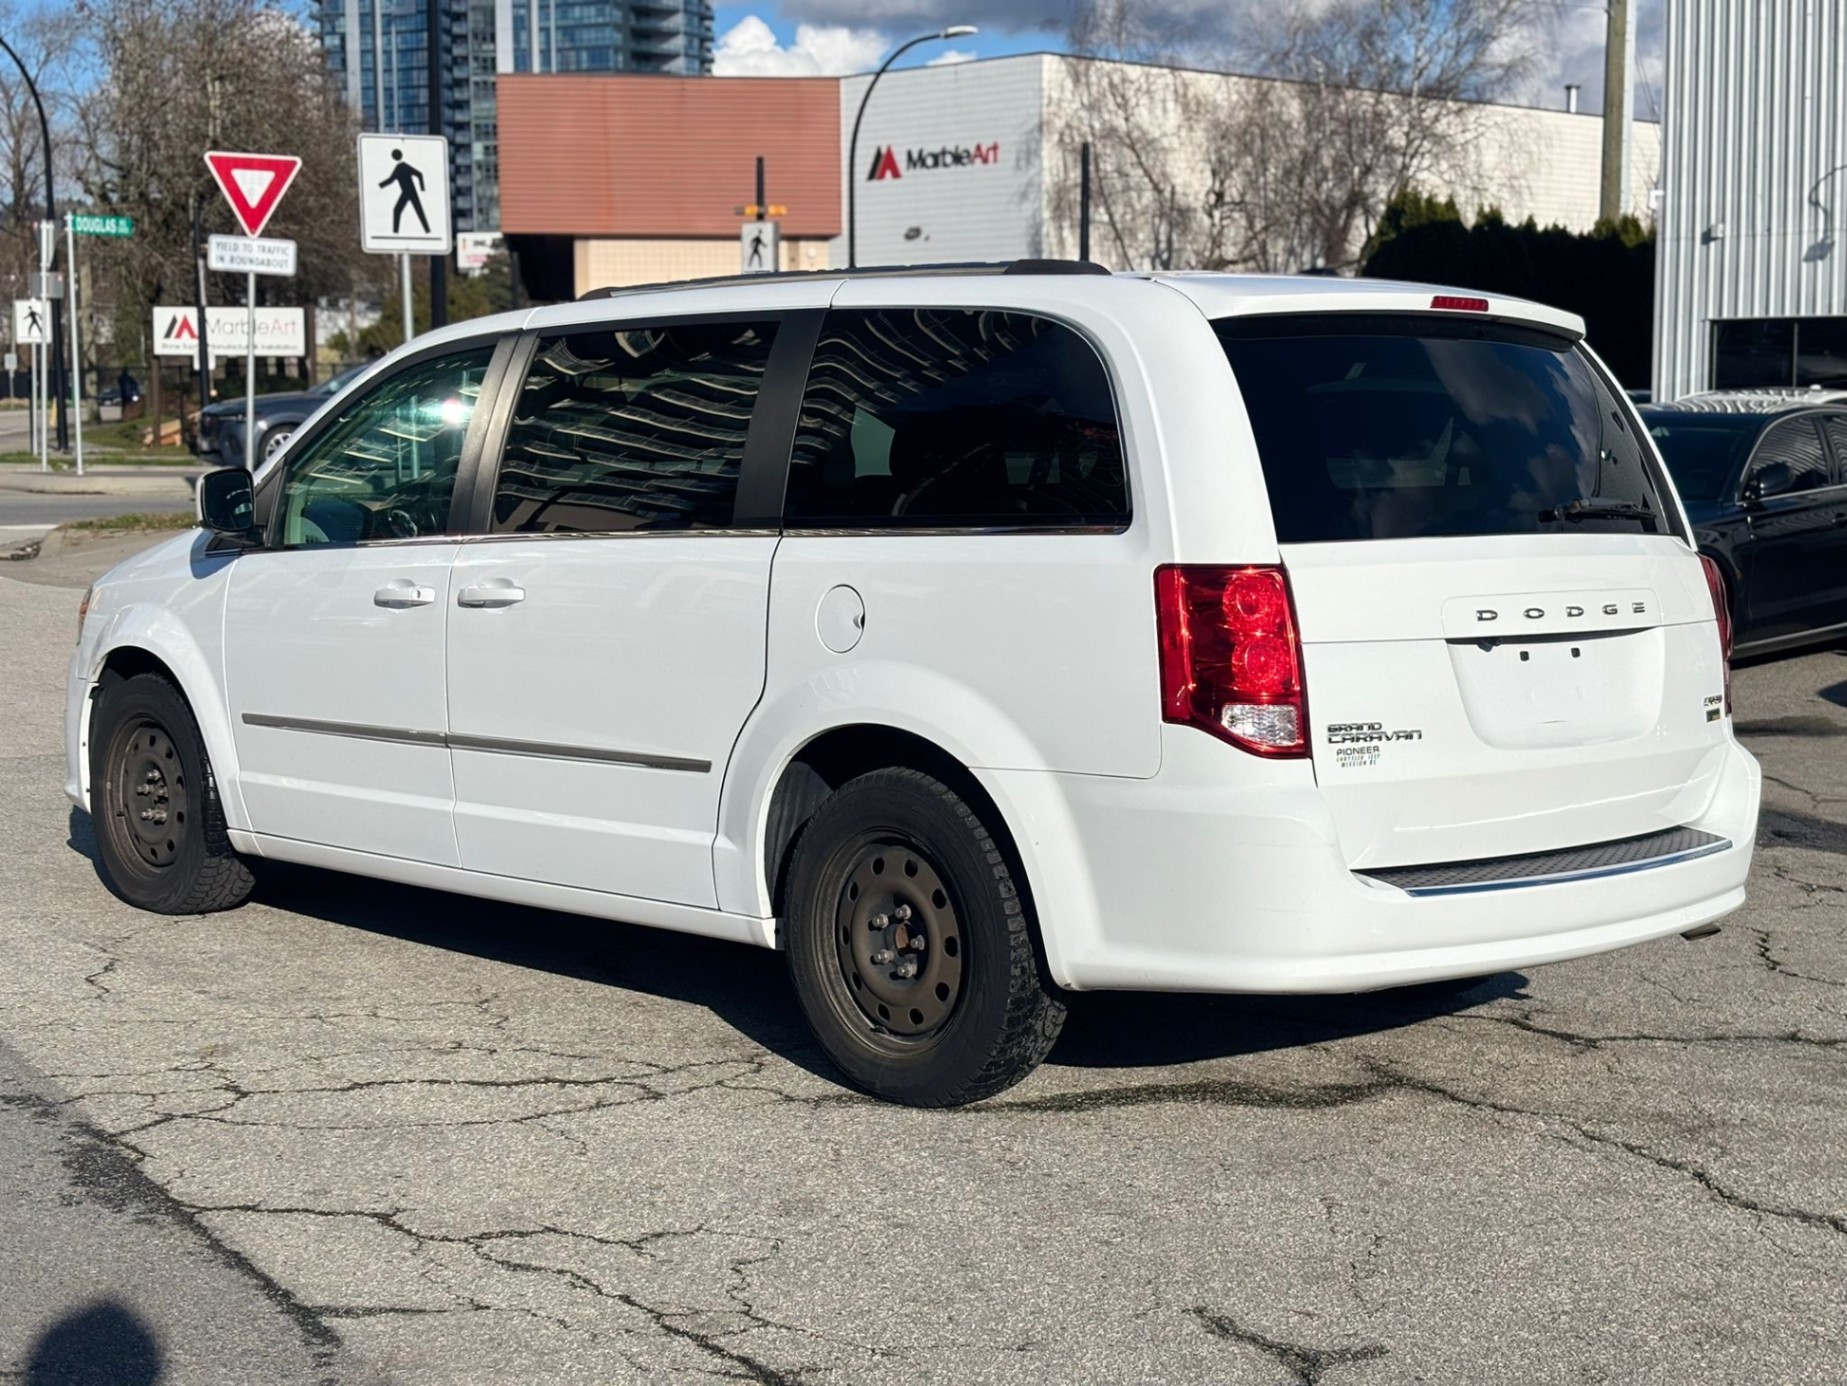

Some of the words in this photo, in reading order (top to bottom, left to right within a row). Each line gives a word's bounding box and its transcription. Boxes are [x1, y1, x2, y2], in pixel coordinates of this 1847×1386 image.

[905, 141, 999, 171] MarbleArt
[76, 216, 116, 234] DOUGLAS
[216, 241, 239, 253] YIELD
[243, 242, 253, 253] TO
[257, 244, 290, 257] TRAFFIC
[216, 254, 225, 263] IN
[229, 255, 289, 269] ROUNDABOUT
[1476, 602, 1646, 621] DODGE
[1327, 722, 1382, 733] GRAND
[1327, 729, 1422, 744] CARAVAN
[1336, 745, 1380, 756] PIONEER
[1341, 760, 1367, 768] MISSION
